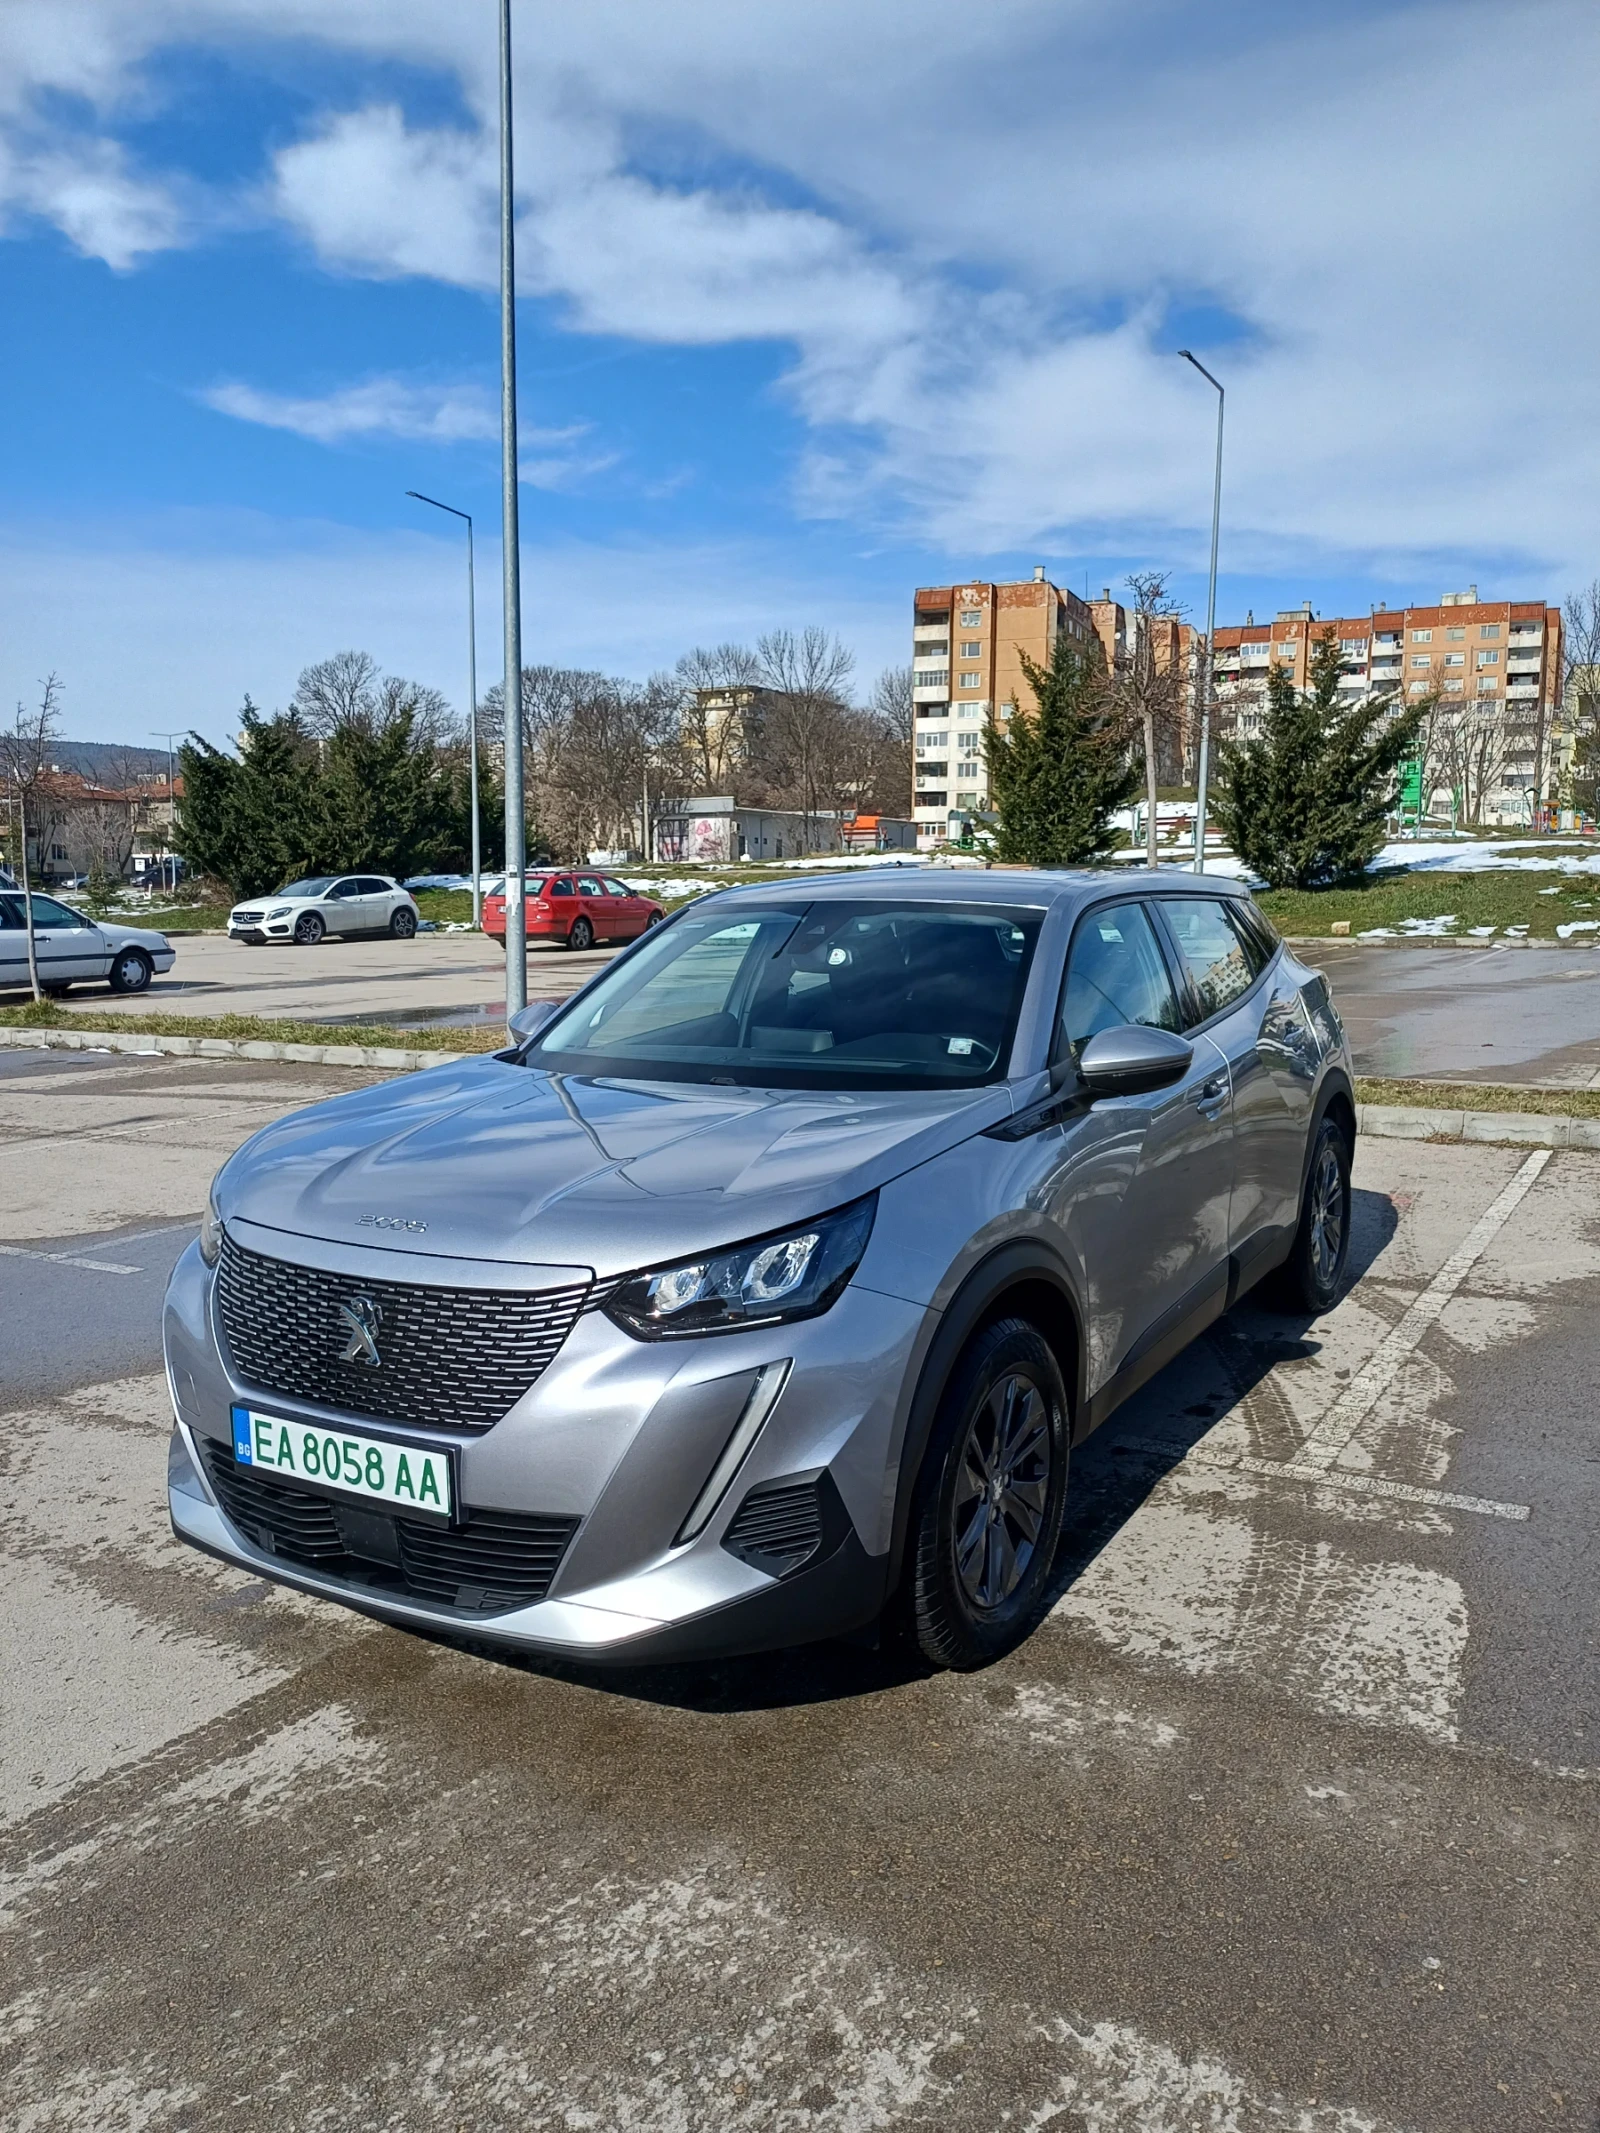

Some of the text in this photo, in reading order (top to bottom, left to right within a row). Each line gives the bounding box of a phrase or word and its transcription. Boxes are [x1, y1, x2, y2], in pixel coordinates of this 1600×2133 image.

[355, 1213, 428, 1233] 2008
[238, 1441, 251, 1457] BG
[255, 1419, 441, 1505] EA 8058 AA
